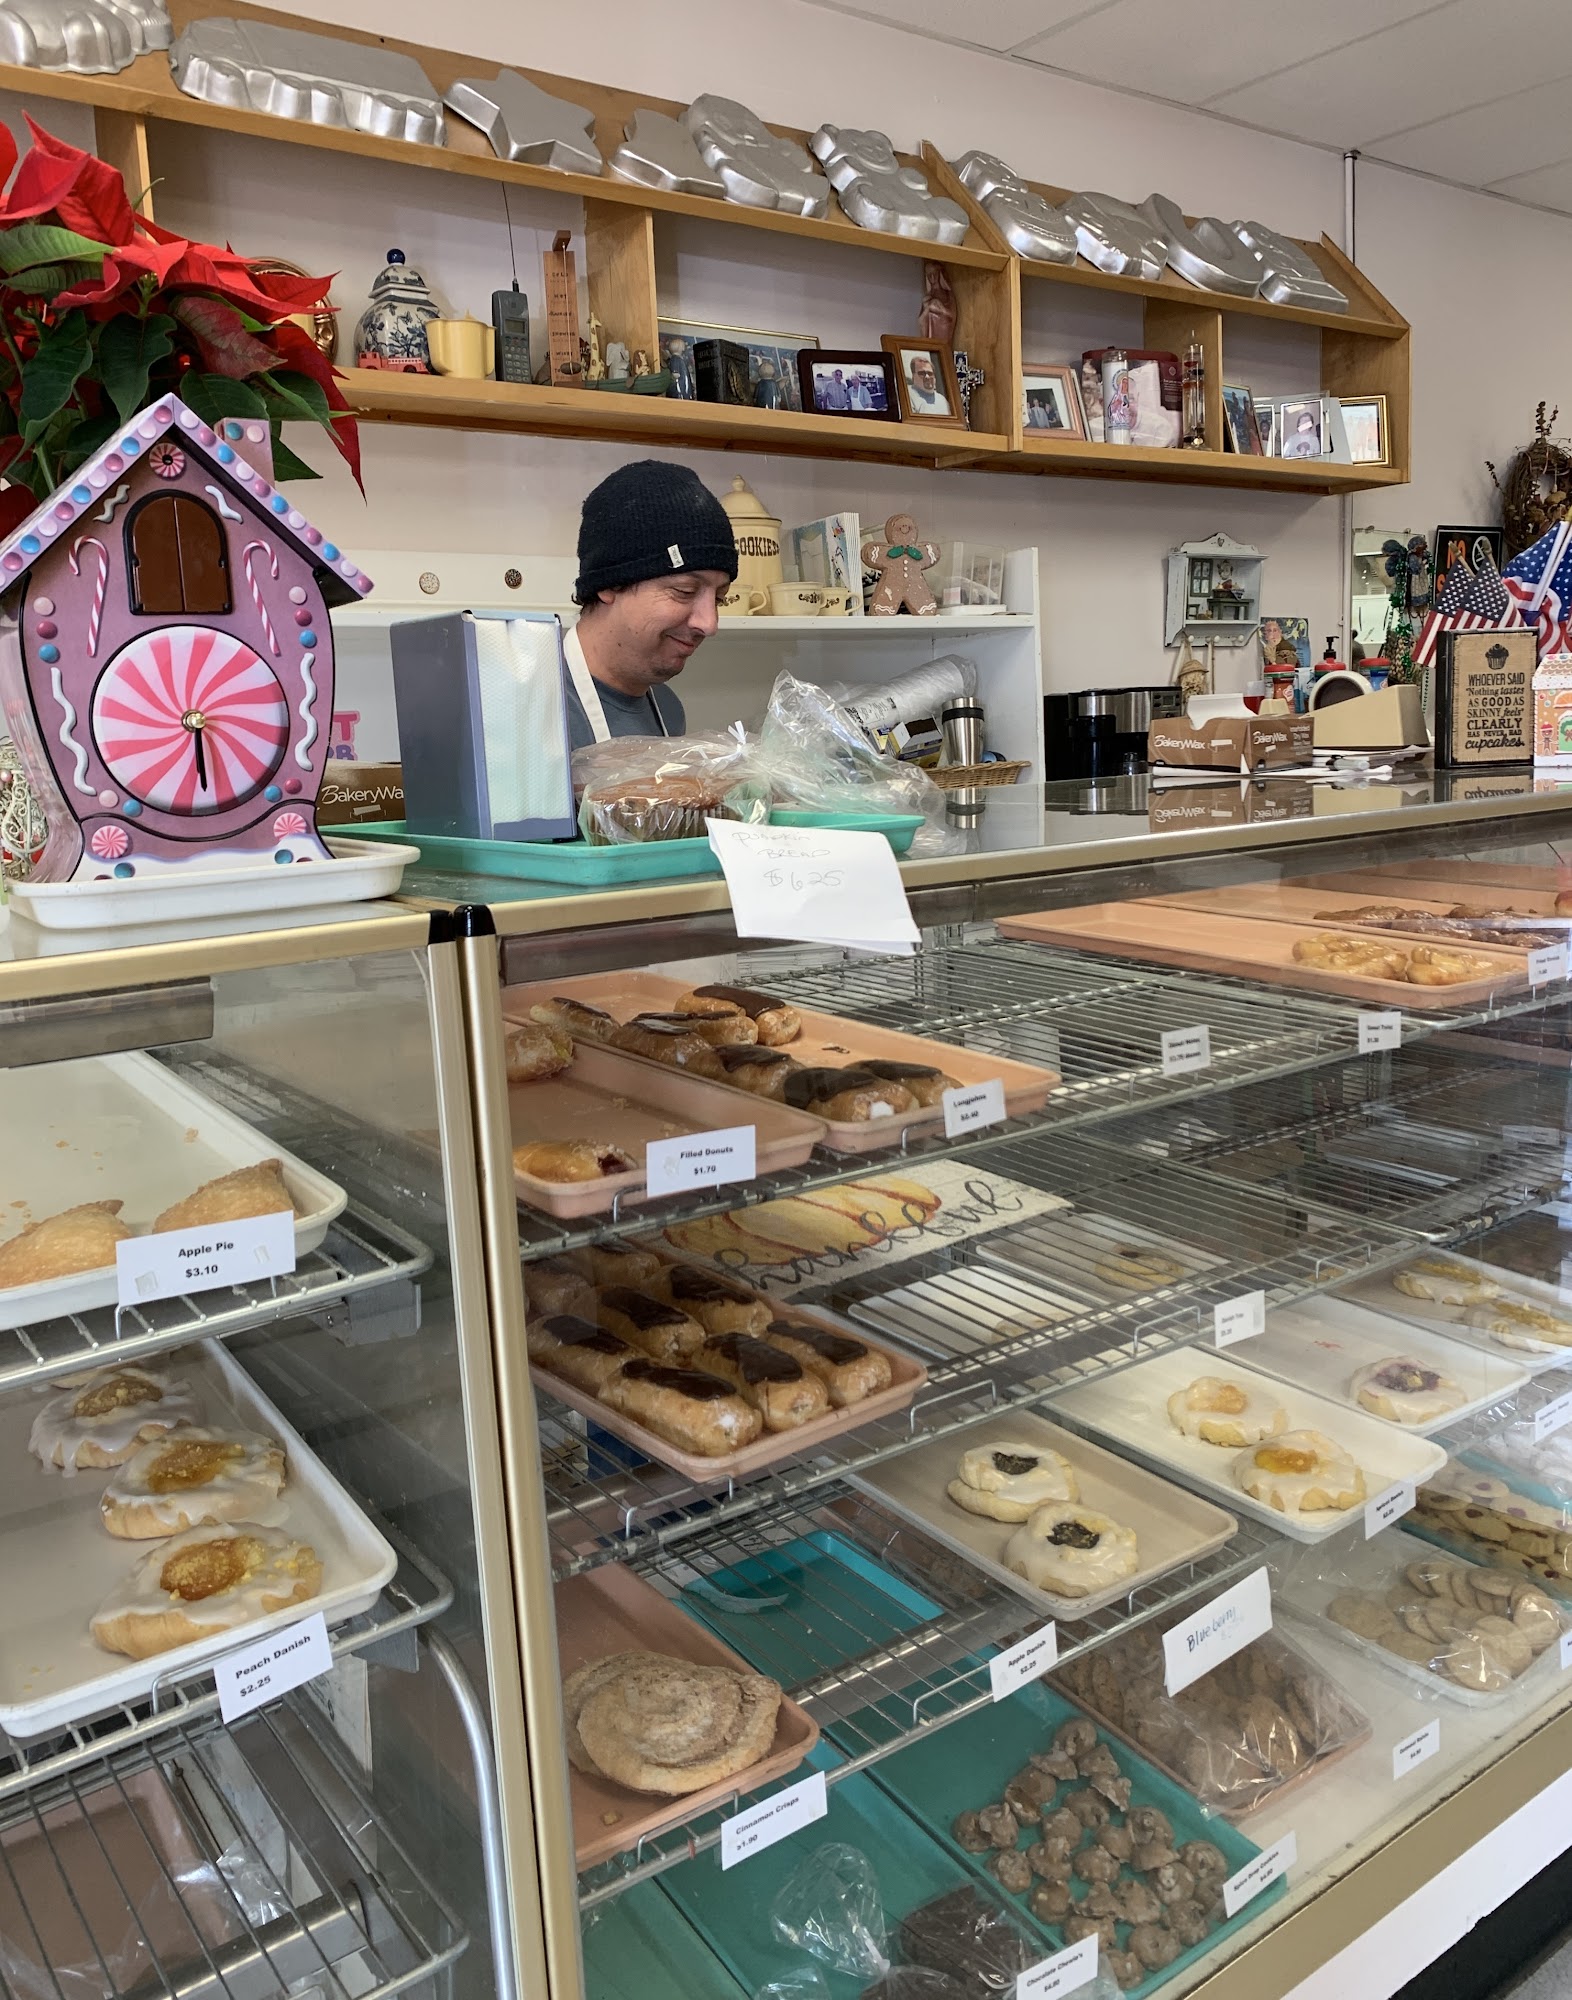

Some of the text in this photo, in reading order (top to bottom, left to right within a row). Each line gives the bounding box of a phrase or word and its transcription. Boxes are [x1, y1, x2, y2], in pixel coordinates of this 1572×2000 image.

[1468, 672, 1525, 686] WHOEVER SAID
[1500, 687, 1525, 695] tastes
[1468, 696, 1525, 708] AS GOOD AS
[1467, 708, 1501, 718] SKINNY
[1467, 718, 1523, 731] CLEARLY
[1253, 731, 1288, 746] BakeryWax
[1467, 730, 1480, 738] HAS
[1154, 735, 1206, 750] BakeryWax
[321, 785, 405, 805] BakeryWa
[680, 1146, 734, 1159] Filled Donuts
[694, 1165, 717, 1176] $1.70
[178, 1242, 234, 1258] Apple Pie
[185, 1264, 219, 1278] $3.10
[235, 1635, 311, 1680] Peach Danish
[1008, 1640, 1046, 1668] Apple Danish
[1020, 1660, 1037, 1675] $2.25
[239, 1675, 271, 1697] $2.25
[735, 1797, 800, 1835] Cinnamon Crisps
[1026, 1968, 1057, 1987] Chocolate
